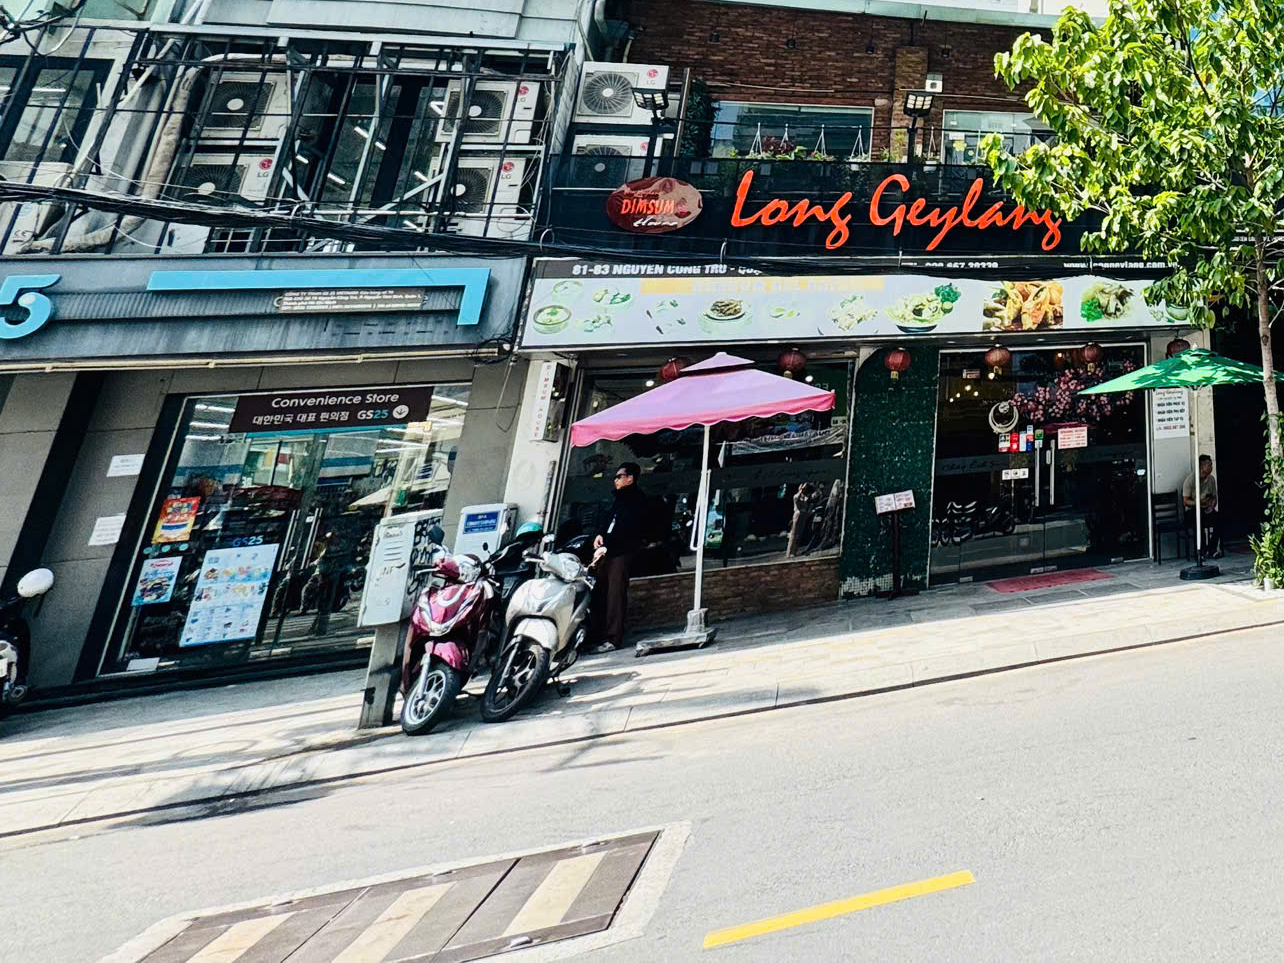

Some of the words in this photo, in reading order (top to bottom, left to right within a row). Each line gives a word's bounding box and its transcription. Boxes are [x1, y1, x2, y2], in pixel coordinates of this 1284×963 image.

[621, 198, 675, 215] DIMSUM
[730, 169, 853, 250] Long
[869, 173, 1062, 251] Geylang
[572, 264, 609, 275] 81-83
[271, 394, 361, 409] Convenience
[365, 393, 400, 405] Store
[252, 413, 294, 426] 대한민국
[296, 412, 317, 423] 대표
[319, 411, 350, 423] 편의점
[356, 409, 389, 421] GS25
[232, 535, 264, 547] GS25
